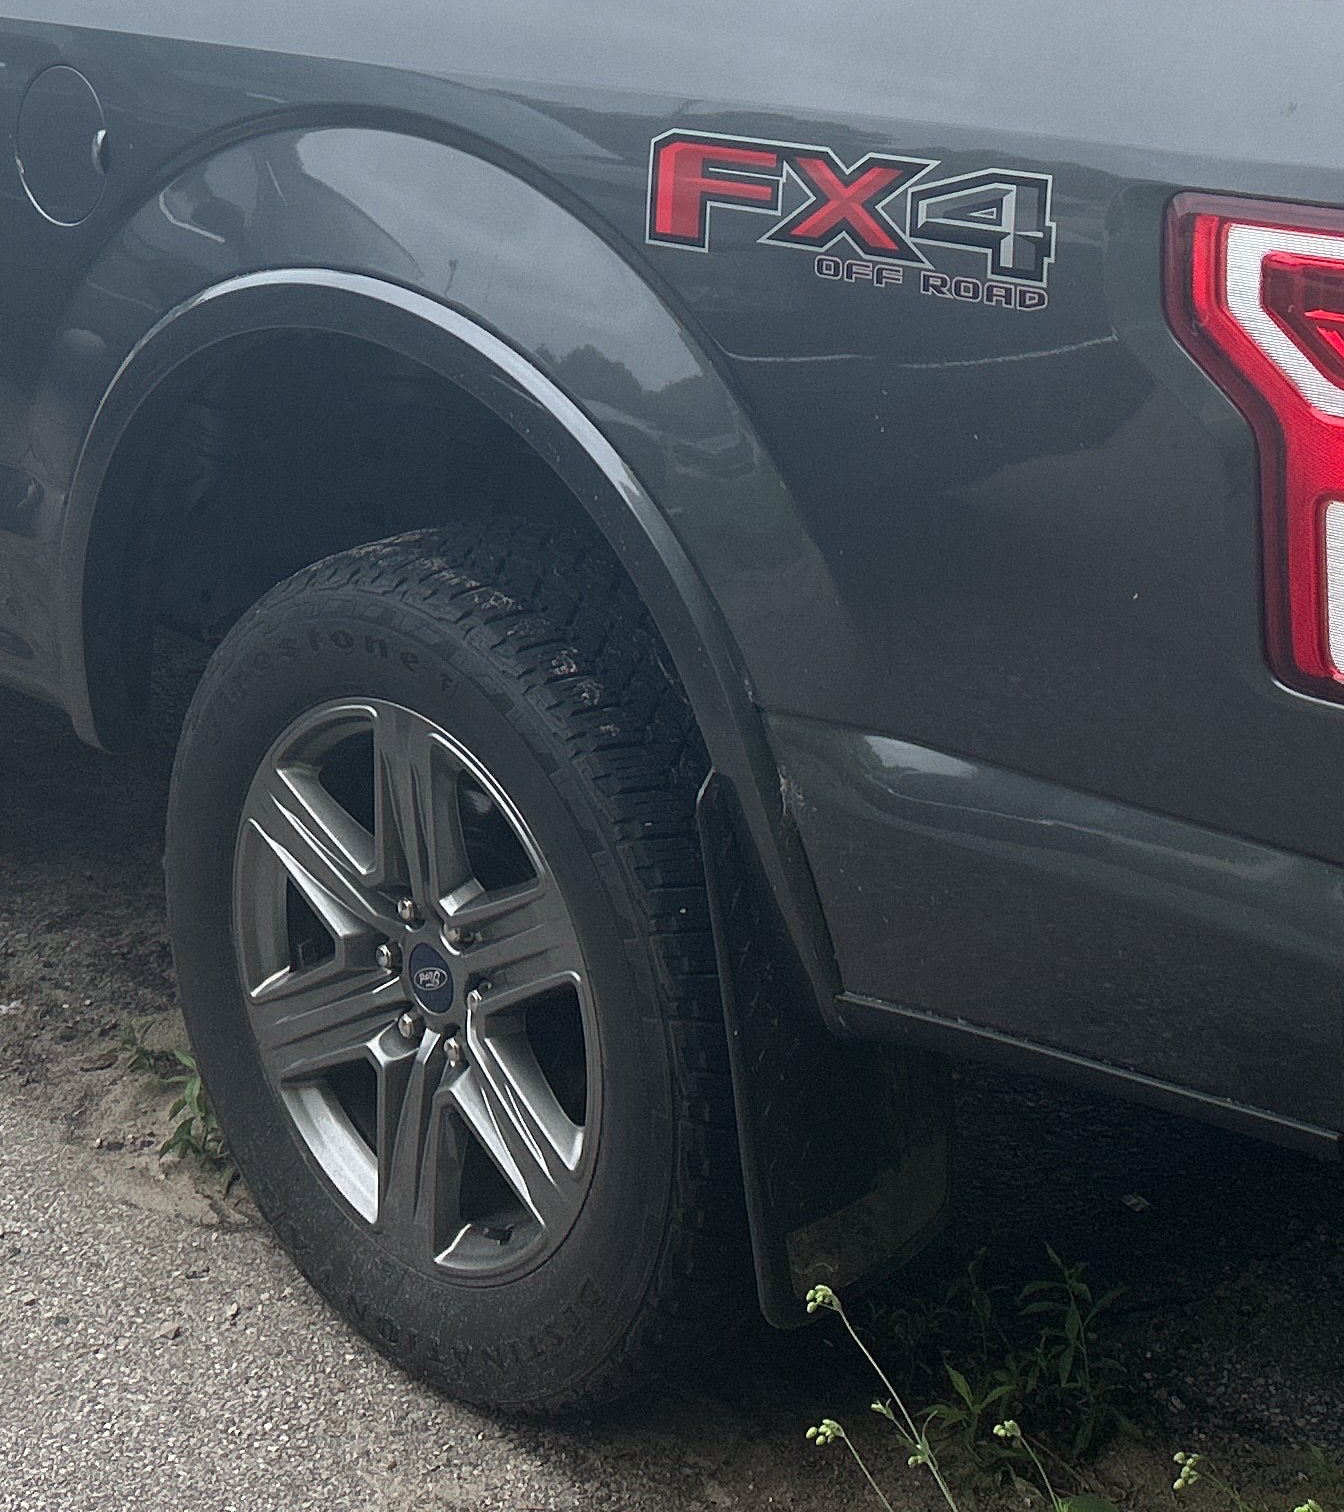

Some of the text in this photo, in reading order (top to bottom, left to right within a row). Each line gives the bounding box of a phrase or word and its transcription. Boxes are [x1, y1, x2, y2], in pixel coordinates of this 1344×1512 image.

[646, 128, 1055, 287] FX4
[815, 256, 1049, 312] OFF ROAD
